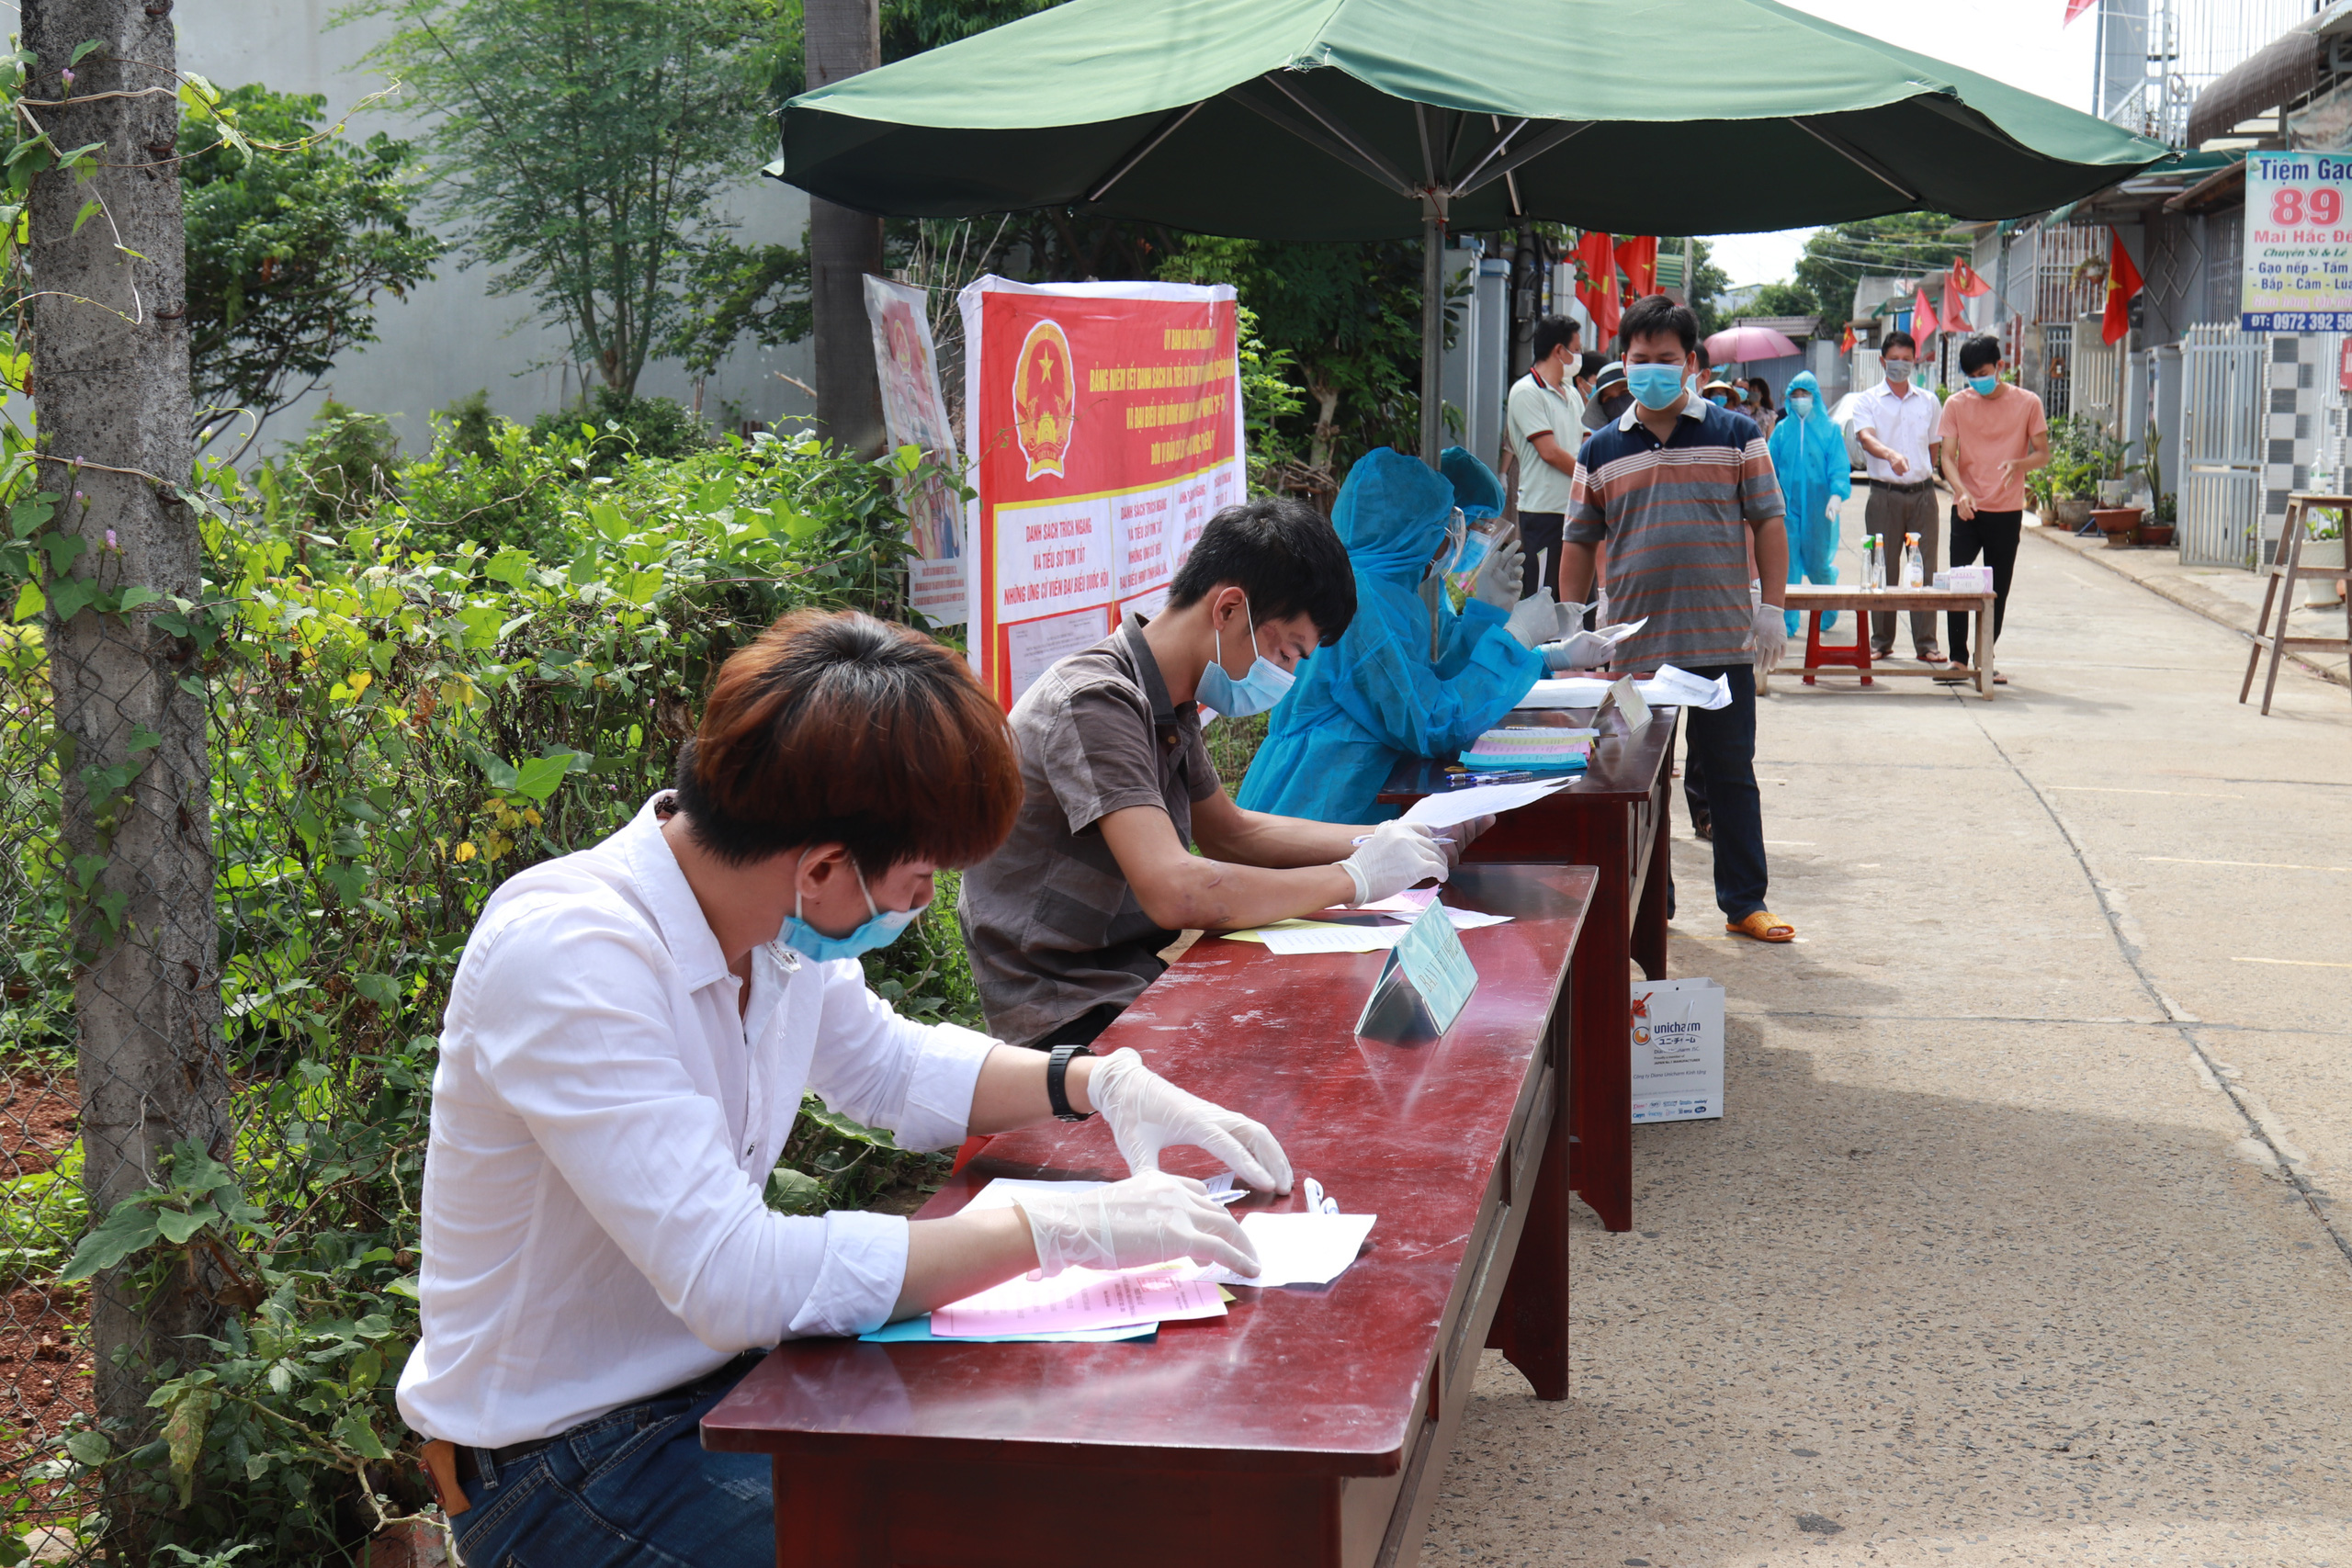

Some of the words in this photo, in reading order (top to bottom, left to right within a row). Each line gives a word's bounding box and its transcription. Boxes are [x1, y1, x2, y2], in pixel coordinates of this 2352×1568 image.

[2259, 158, 2310, 186] Tiệm
[2269, 186, 2345, 228] 89
[2254, 230, 2287, 243] Mai
[2293, 227, 2326, 243] Hắc
[2321, 248, 2331, 257] &
[2258, 261, 2282, 276] Gạo
[2287, 260, 2309, 276] nếp
[2323, 260, 2348, 274] Tấm
[2261, 276, 2284, 292] Bắp
[2251, 314, 2271, 327] ĐT:
[2273, 313, 2306, 331] 0972
[2309, 313, 2335, 331] 392
[1090, 361, 1109, 392] BẢNG
[1026, 525, 1042, 543] DANH
[1044, 519, 1058, 540] SÁCH
[1059, 517, 1074, 537] TRÍCH
[1075, 517, 1092, 536] NGANG
[1034, 551, 1042, 570] VÀ
[1043, 545, 1055, 570] TIỂU
[1057, 545, 1064, 568] SỬ
[1065, 546, 1076, 566] TÓM
[1077, 541, 1085, 564] TẮT
[1004, 583, 1025, 605] NHỮNG
[1049, 577, 1062, 597] VIÊN
[1064, 578, 1073, 598] ĐẠI
[1073, 570, 1084, 593] BIỂU
[1086, 568, 1099, 592] QUỐC
[1100, 568, 1109, 591] HỘI
[1654, 1021, 1701, 1034] unicharm
[1658, 1037, 1696, 1045] ユニ・チーム
